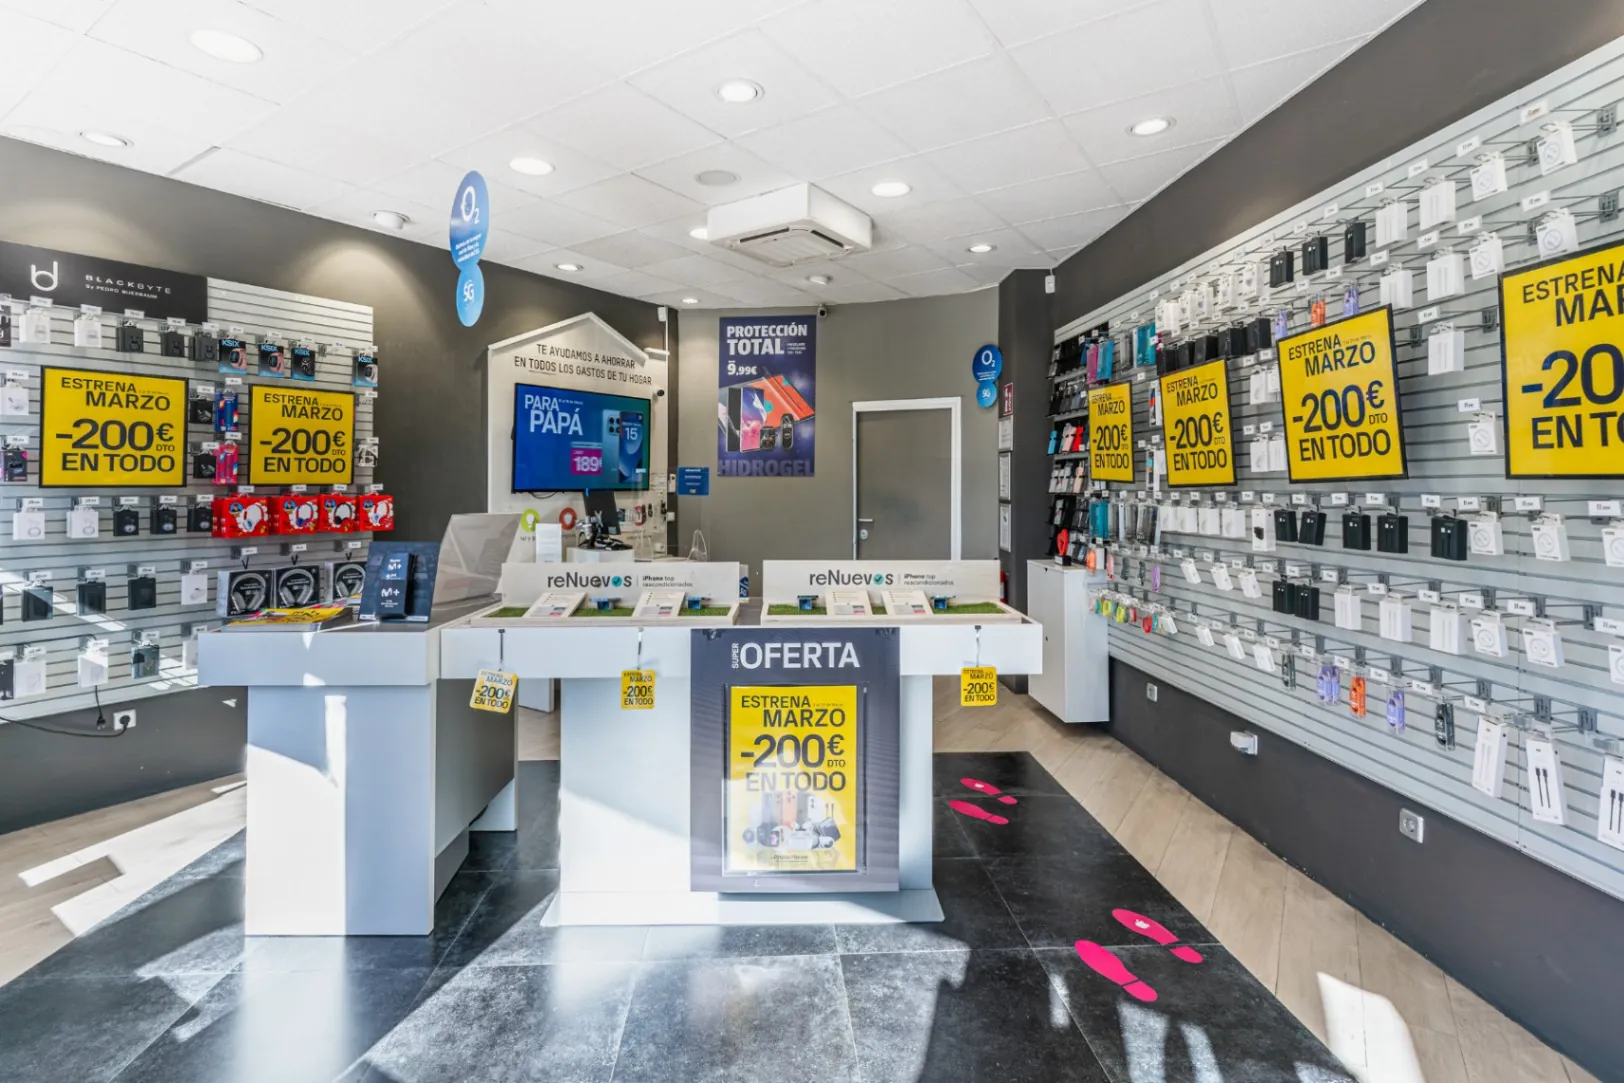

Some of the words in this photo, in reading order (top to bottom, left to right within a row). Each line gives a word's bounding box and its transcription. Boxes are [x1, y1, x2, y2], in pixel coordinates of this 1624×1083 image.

[85, 274, 172, 295] BLACKBYTE
[96, 285, 119, 294] PEDRO
[726, 323, 808, 338] PROTECCIÓN
[221, 339, 240, 348] KSIX
[727, 339, 785, 356] TOTAL
[1288, 333, 1342, 361] ESTRENA
[537, 343, 547, 354] TE
[550, 346, 592, 362] AYUDAMOS
[594, 354, 601, 363] A
[601, 355, 636, 369] AHORRAR
[1304, 341, 1376, 378] MARZO
[514, 355, 526, 367] EN
[528, 357, 556, 372] TODOS
[559, 362, 574, 375] LOS
[576, 367, 606, 379] GASTOS
[607, 370, 617, 381] DE
[619, 372, 628, 382] TU
[629, 375, 652, 386] HOGAR
[61, 377, 137, 393] ESTRENA
[1166, 375, 1199, 393] ESTRENA
[86, 391, 171, 411] MARZO
[264, 393, 319, 406] ESTRENA
[525, 394, 560, 412] PARA
[1176, 382, 1218, 407] MARZO
[281, 404, 343, 421] MARZO
[1097, 400, 1126, 416] MARZO
[530, 408, 584, 436] PAPÁ
[1368, 412, 1388, 425] DTO
[625, 427, 638, 440] 15
[1532, 413, 1584, 449] EN
[1589, 411, 1624, 447] T
[156, 444, 175, 452] DTO
[1299, 437, 1326, 462] EN
[1326, 429, 1391, 460] TODO
[62, 453, 99, 472] EN
[103, 454, 175, 473] TODO
[264, 457, 291, 473] EN
[294, 457, 346, 473] TODO
[719, 459, 816, 476] HIDROGEL
[1095, 453, 1105, 468] EN
[1105, 453, 1130, 469] TODO
[1173, 453, 1190, 472] EN
[1189, 448, 1228, 470] TODO
[731, 642, 739, 669] SUPER
[740, 641, 860, 669] OFERTA
[486, 675, 513, 686] MARZO
[970, 672, 994, 680] MARZO
[634, 698, 654, 706] TODO
[741, 695, 811, 708] ESTRENA
[976, 694, 996, 702] TODO
[763, 708, 846, 728] MARZO
[827, 759, 846, 768] DTO
[745, 772, 777, 792] EN
[781, 771, 846, 792] TODO
